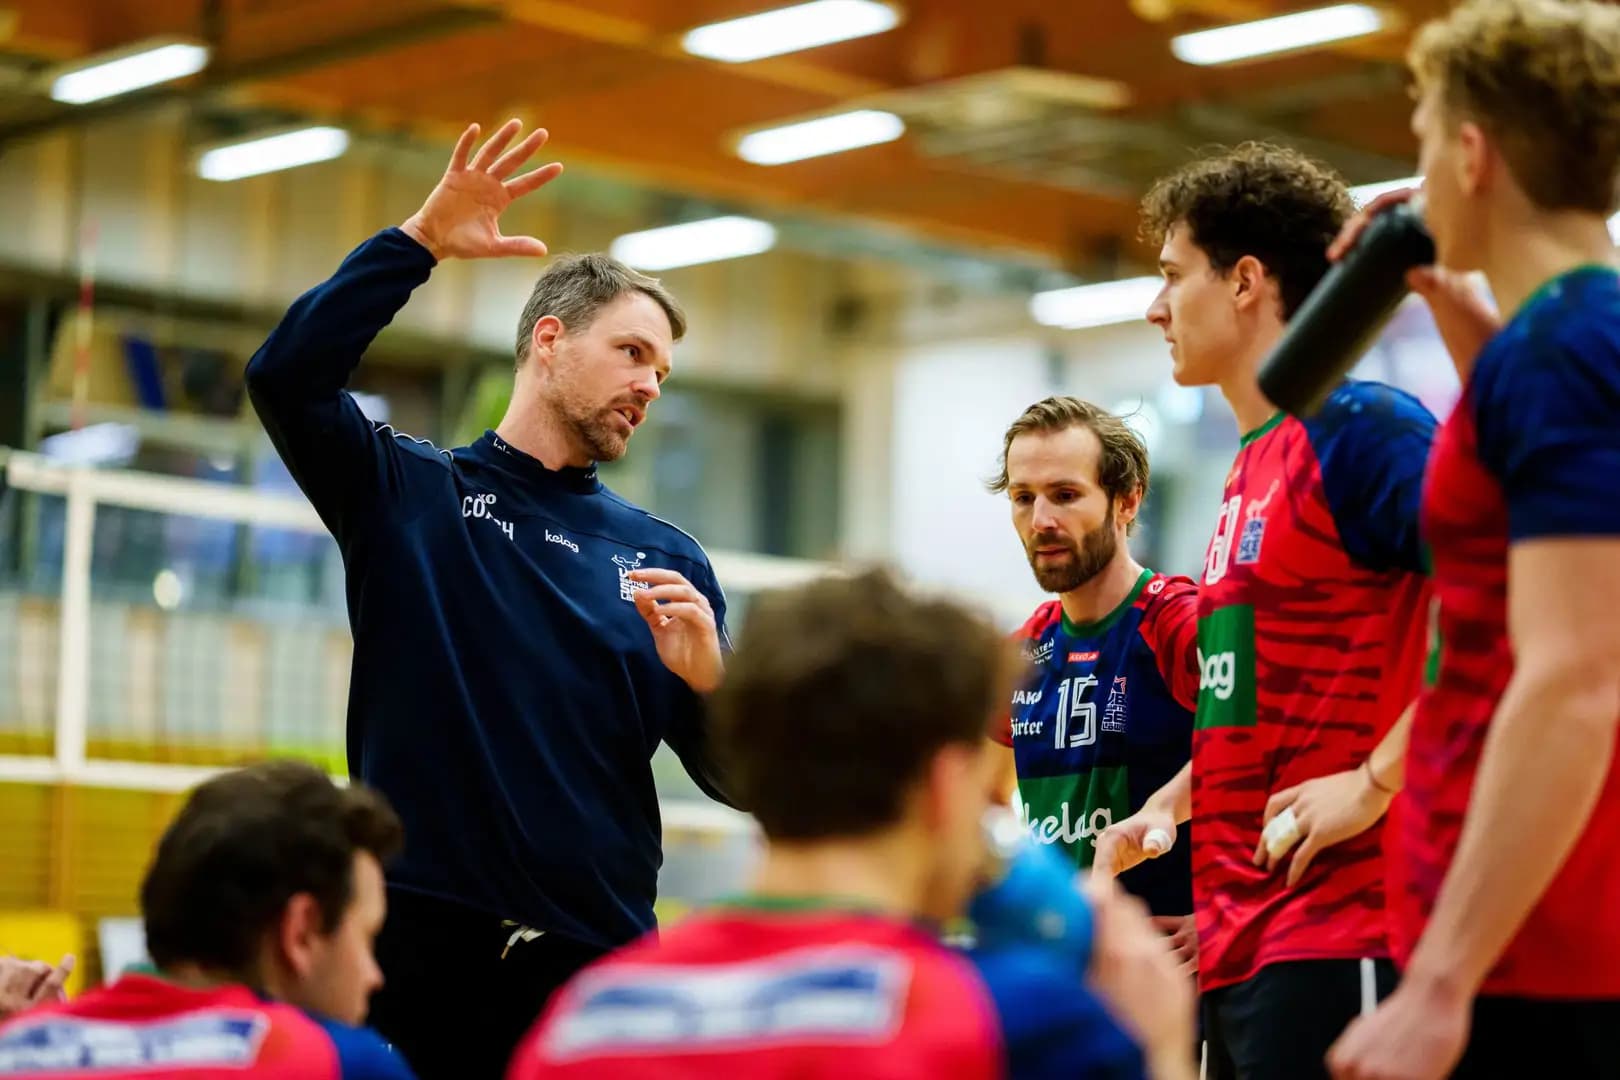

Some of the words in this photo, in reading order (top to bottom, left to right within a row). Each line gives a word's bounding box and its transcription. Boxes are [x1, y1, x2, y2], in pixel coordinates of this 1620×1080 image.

[462, 495, 514, 541] COH
[545, 529, 579, 553] kelag
[1196, 647, 1235, 700] lag
[1011, 690, 1043, 705] JAKO
[1054, 673, 1099, 749] 15
